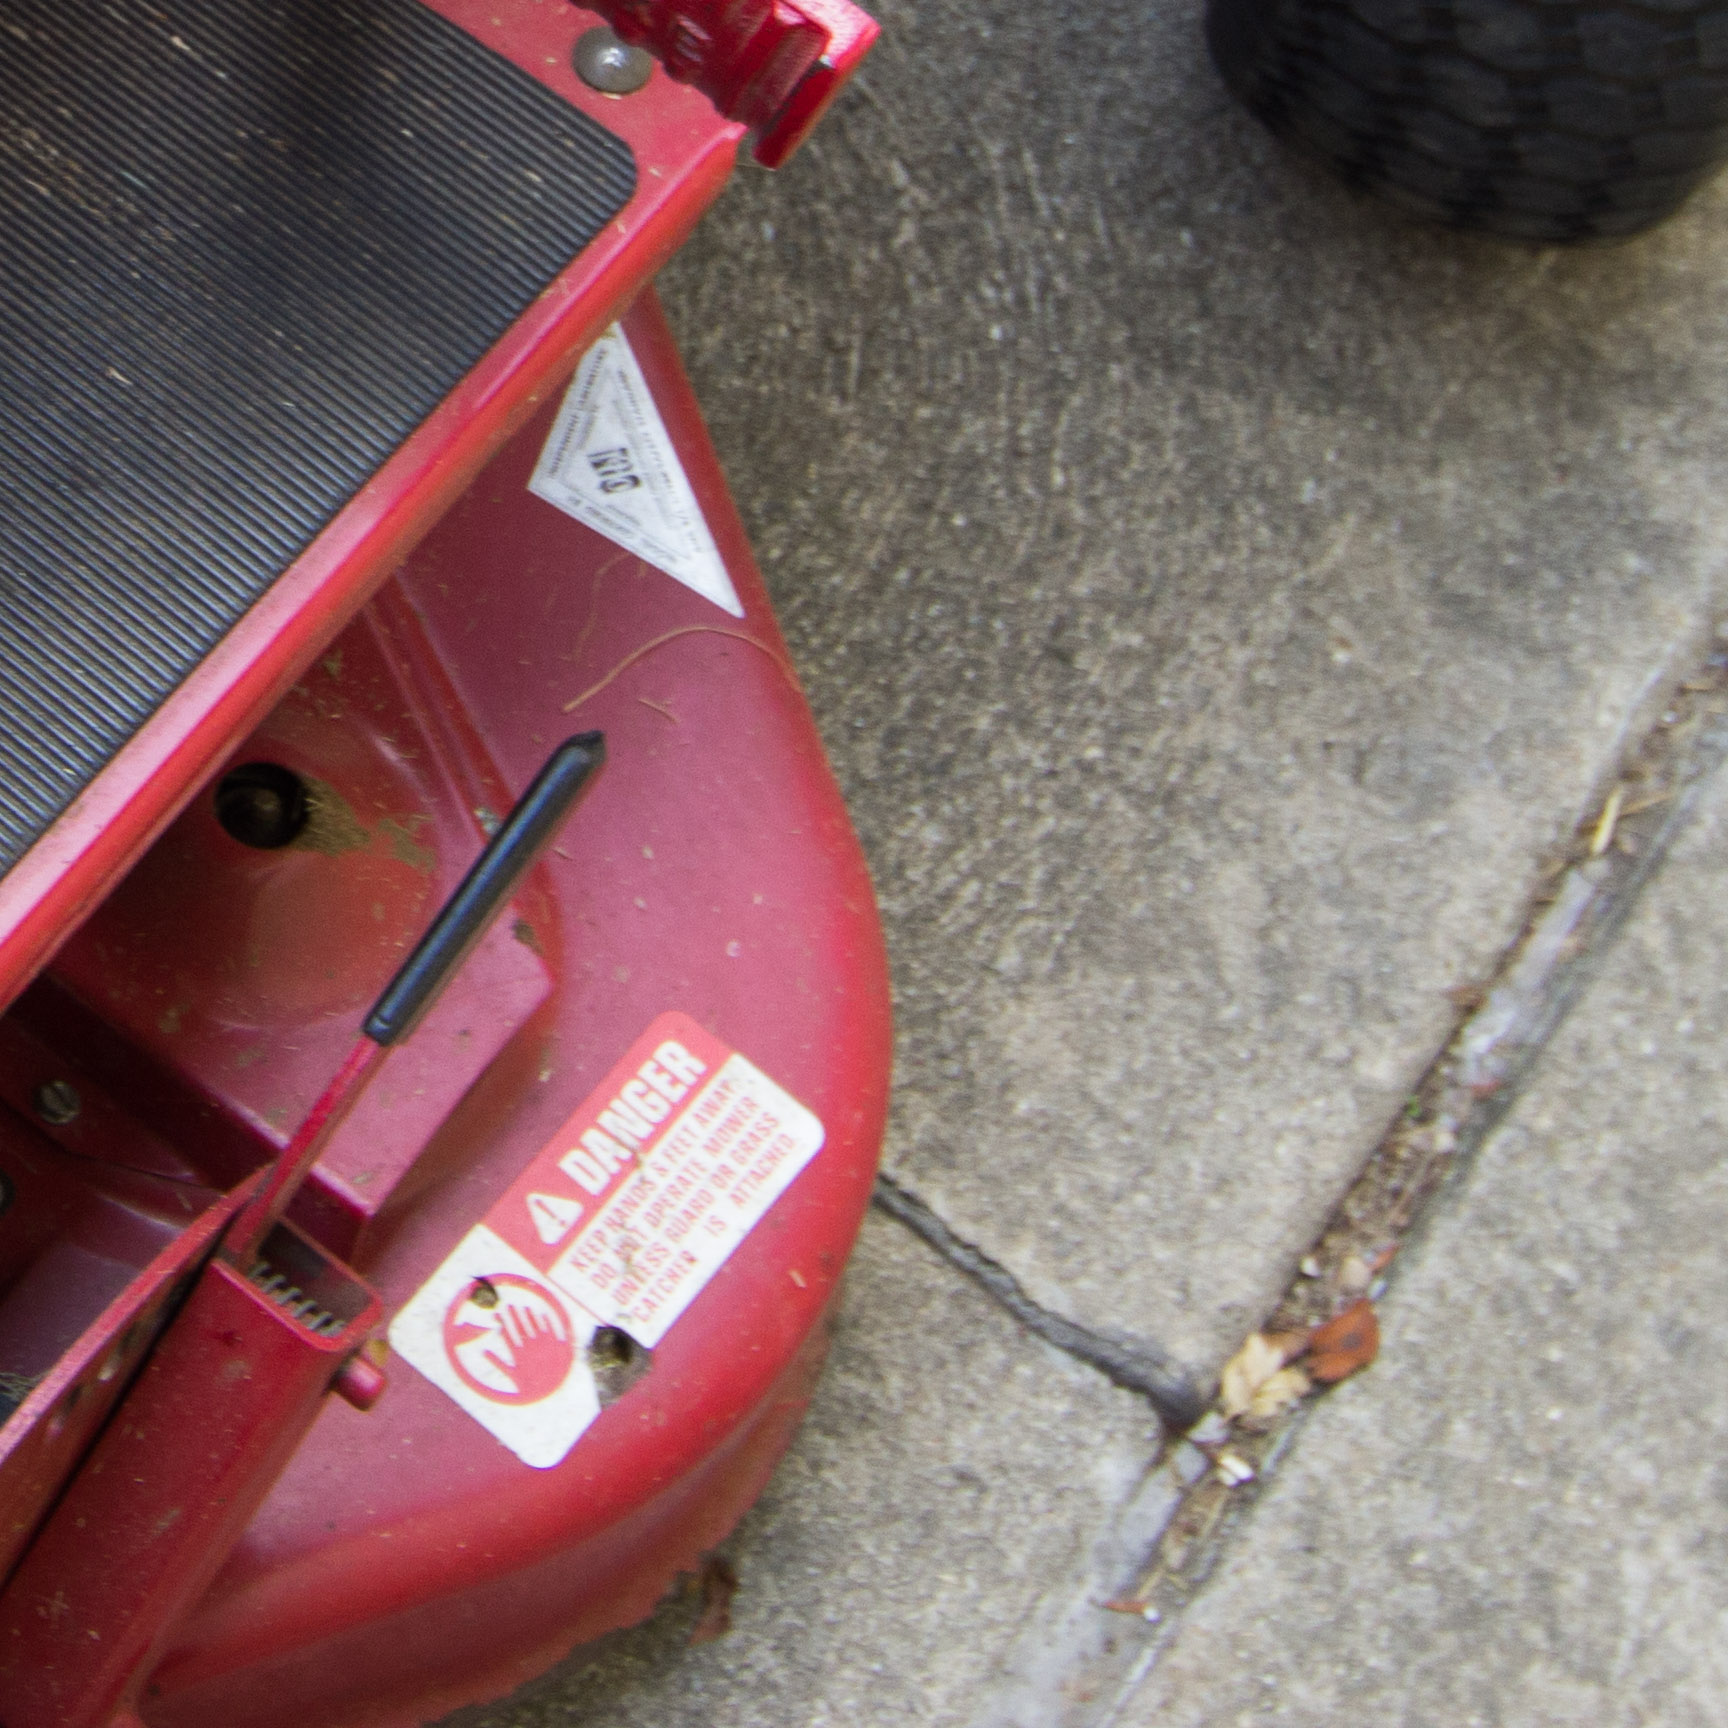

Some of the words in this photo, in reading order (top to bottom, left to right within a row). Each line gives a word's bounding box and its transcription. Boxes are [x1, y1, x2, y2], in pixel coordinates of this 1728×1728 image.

[558, 1040, 706, 1196] DANGER
[591, 1262, 617, 1290] DO
[643, 1157, 708, 1229] OPERATE
[702, 1096, 759, 1157] MOWER
[570, 1229, 608, 1273] KEEP
[603, 1176, 658, 1230] HANDS
[661, 1125, 700, 1165] FEET
[612, 1241, 671, 1306] UNLESS
[664, 1188, 715, 1243] GUARD
[710, 1163, 736, 1189] OR
[729, 1111, 781, 1166] GRASS
[631, 1249, 699, 1323] CATCHER
[703, 1214, 728, 1237] IS
